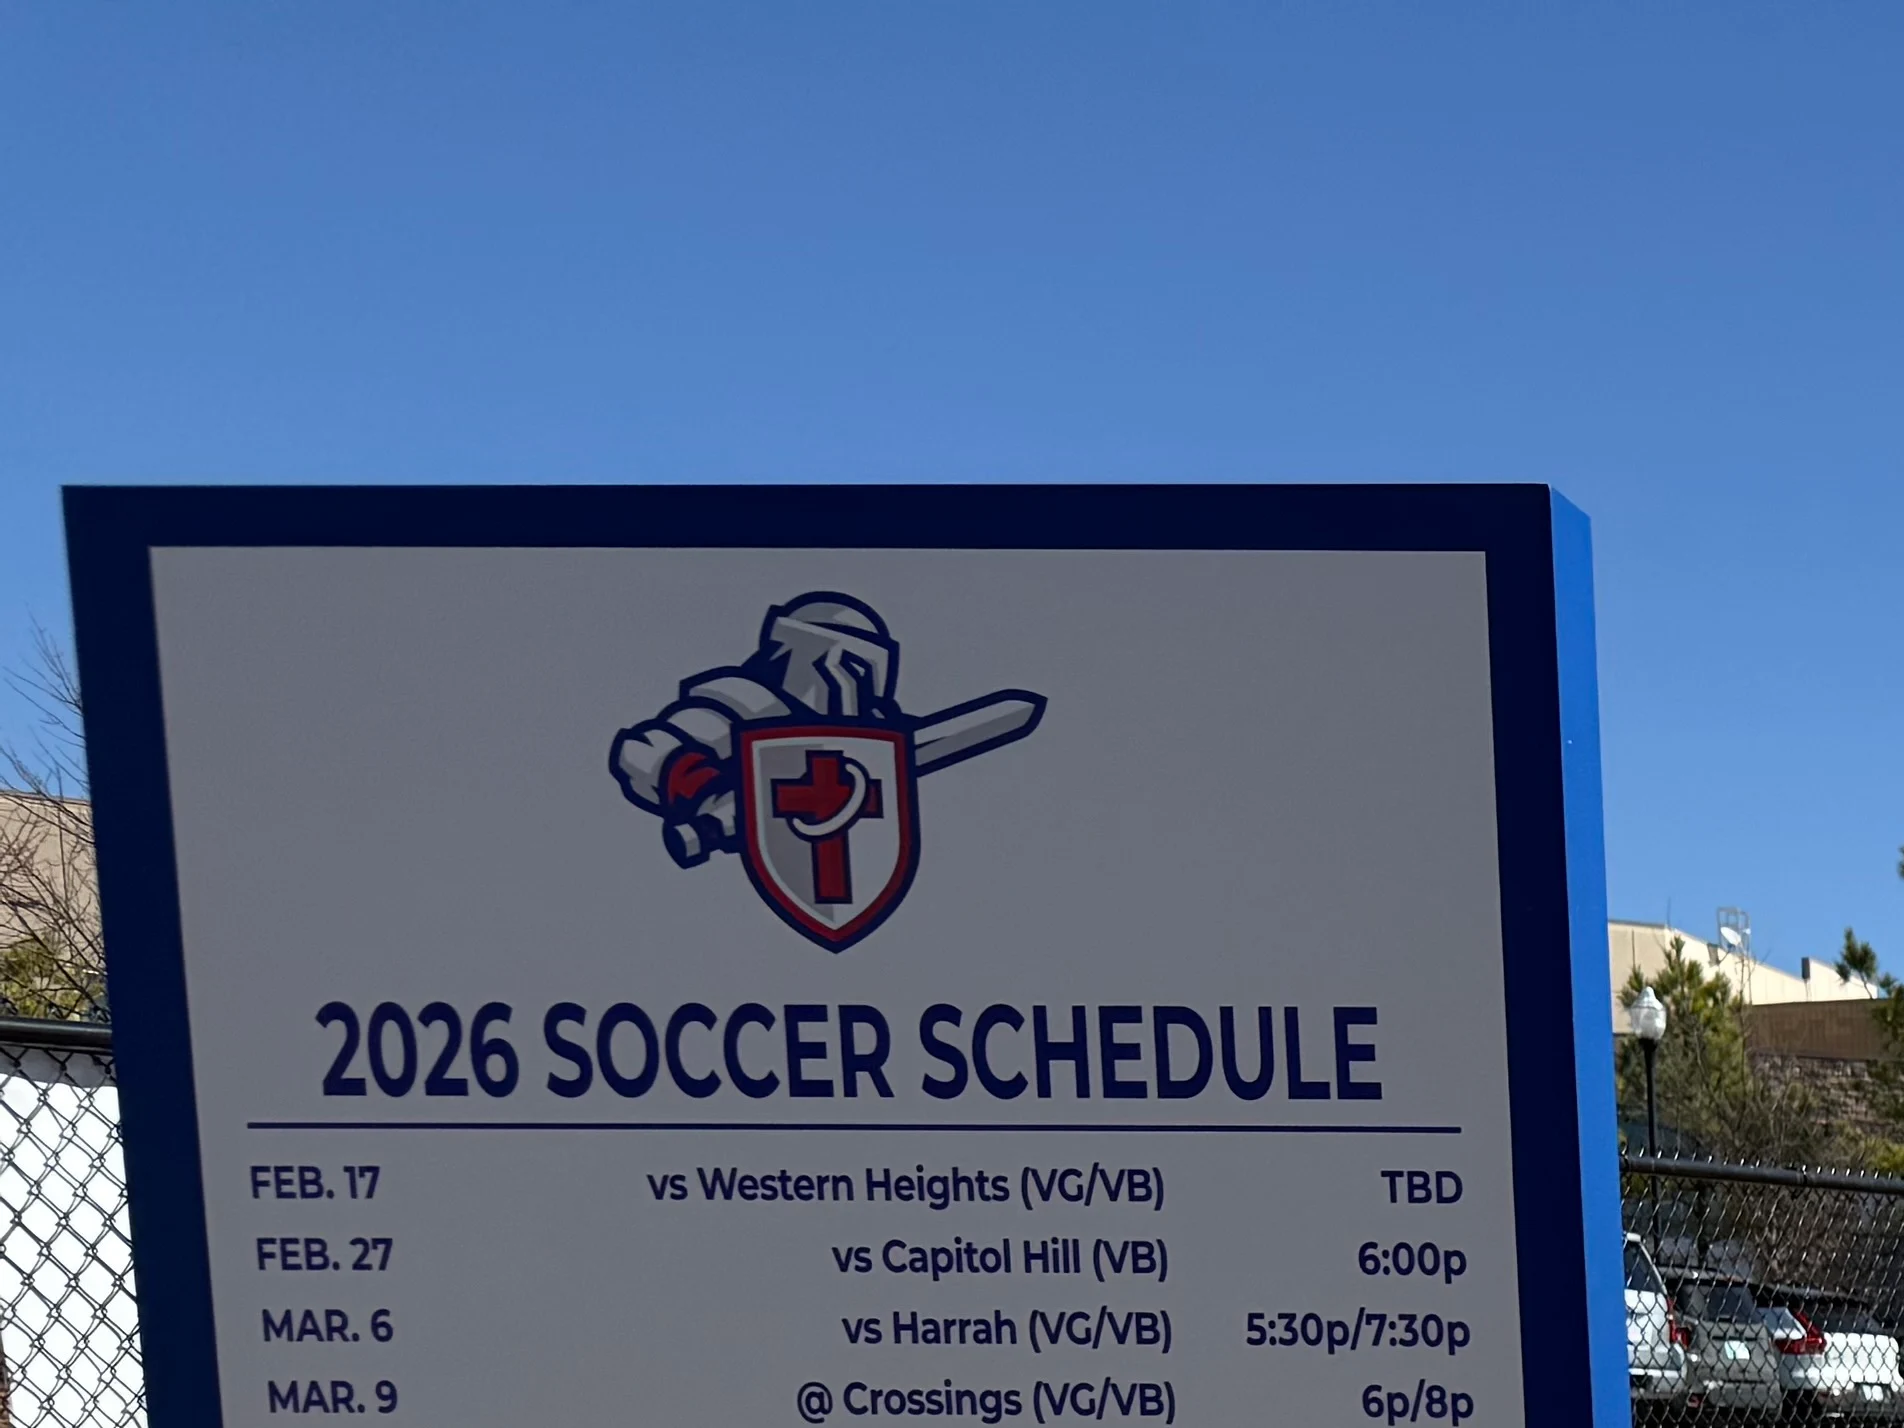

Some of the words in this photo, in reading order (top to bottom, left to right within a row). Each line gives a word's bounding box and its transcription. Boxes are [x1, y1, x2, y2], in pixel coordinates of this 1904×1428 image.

[315, 1001, 520, 1099] 2026
[543, 1002, 895, 1100] SOCCER
[919, 1003, 1383, 1102] SCHEDULE
[250, 1165, 335, 1200] FEB.
[343, 1166, 381, 1200] 17
[647, 1175, 690, 1201] vs
[696, 1167, 855, 1203] Western
[866, 1165, 1011, 1211] Heights
[1021, 1162, 1165, 1212] (VG/VB)
[1381, 1171, 1464, 1205] TBD
[262, 1309, 361, 1343] MAR.
[370, 1308, 394, 1343] 6
[841, 1317, 883, 1345] vs
[893, 1309, 1018, 1346] Harrah
[1029, 1305, 1173, 1355] (VG/VB)
[1247, 1307, 1471, 1356] 5:30p/7:30p
